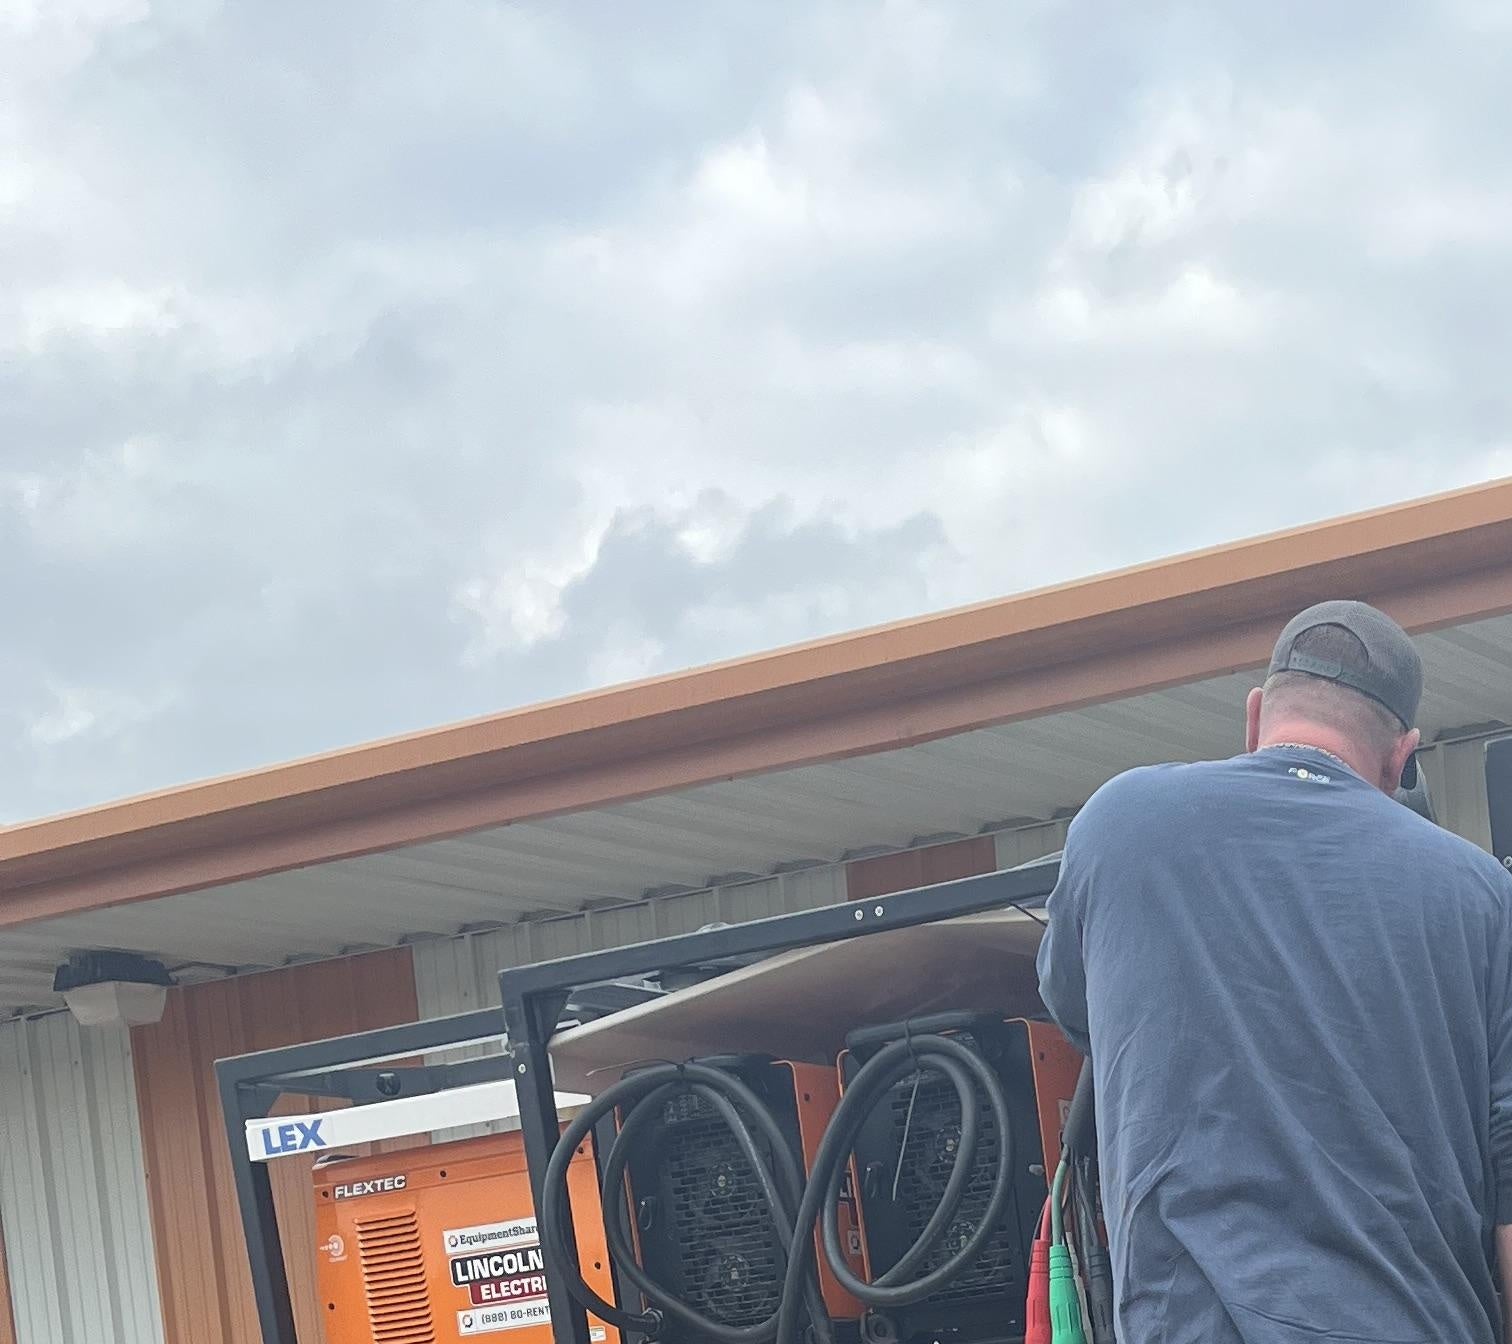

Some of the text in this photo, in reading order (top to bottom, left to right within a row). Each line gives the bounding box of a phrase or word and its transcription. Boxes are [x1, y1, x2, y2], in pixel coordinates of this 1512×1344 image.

[262, 1119, 326, 1155] LEX
[335, 1175, 406, 1199] FLEXTEC
[455, 1249, 544, 1282] LINCOLN
[480, 1275, 547, 1301] ELECTRI
[510, 1305, 550, 1320] 80-RENT
